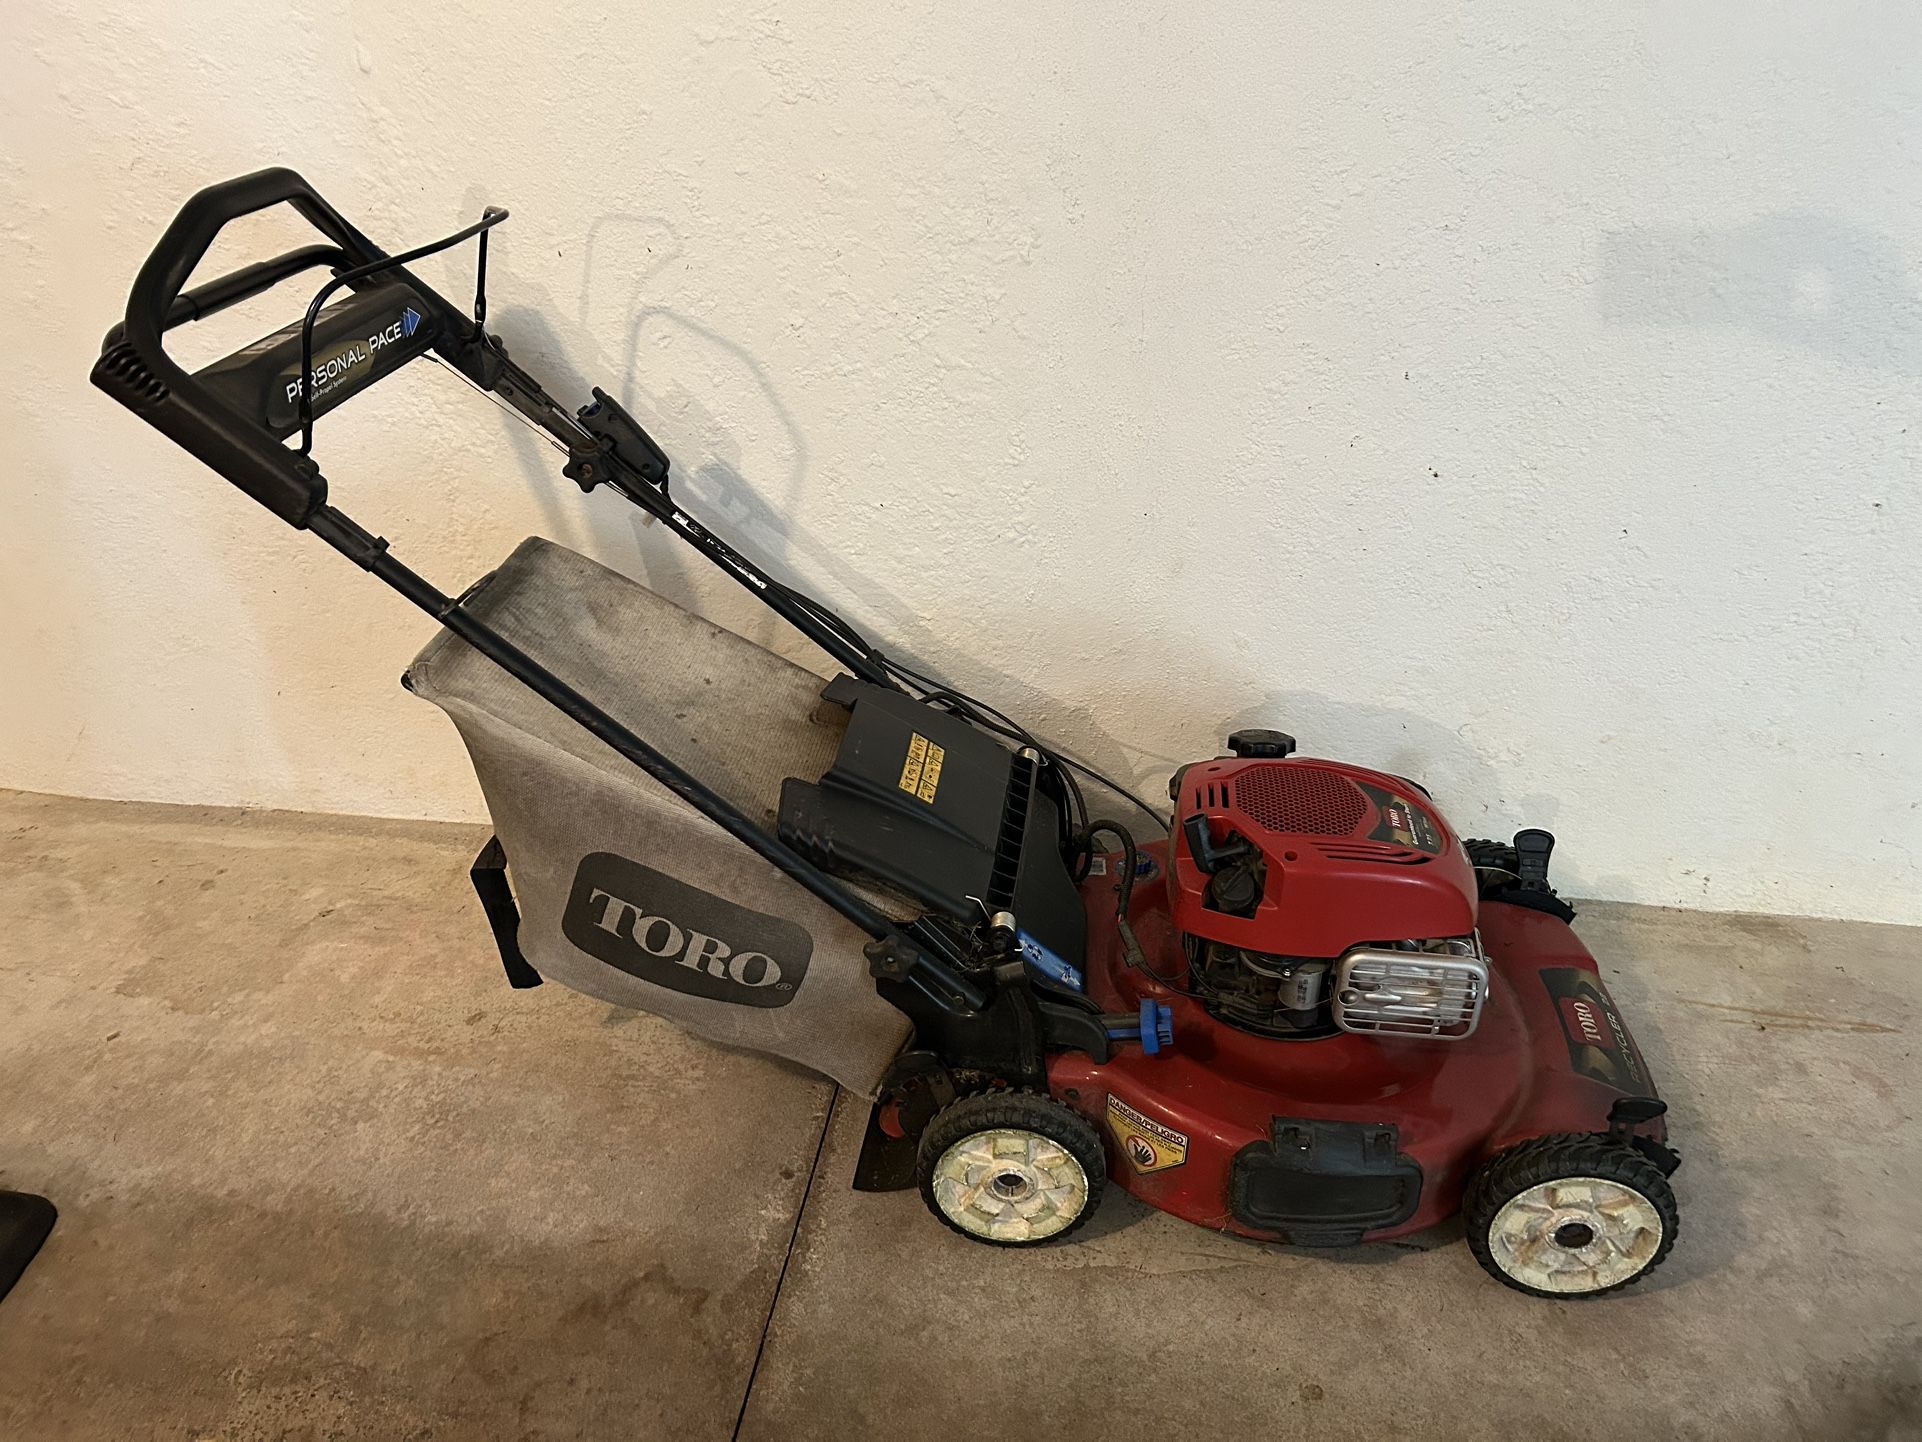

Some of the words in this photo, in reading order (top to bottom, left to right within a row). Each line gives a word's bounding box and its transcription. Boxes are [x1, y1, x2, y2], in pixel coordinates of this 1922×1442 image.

[285, 345, 366, 403] PERSONAL
[368, 321, 401, 353] PACE
[1389, 808, 1401, 827] TORO
[589, 887, 782, 987] TORO
[1573, 1002, 1602, 1041] TORO
[1109, 1098, 1184, 1144] DANGER/PELIGRO
